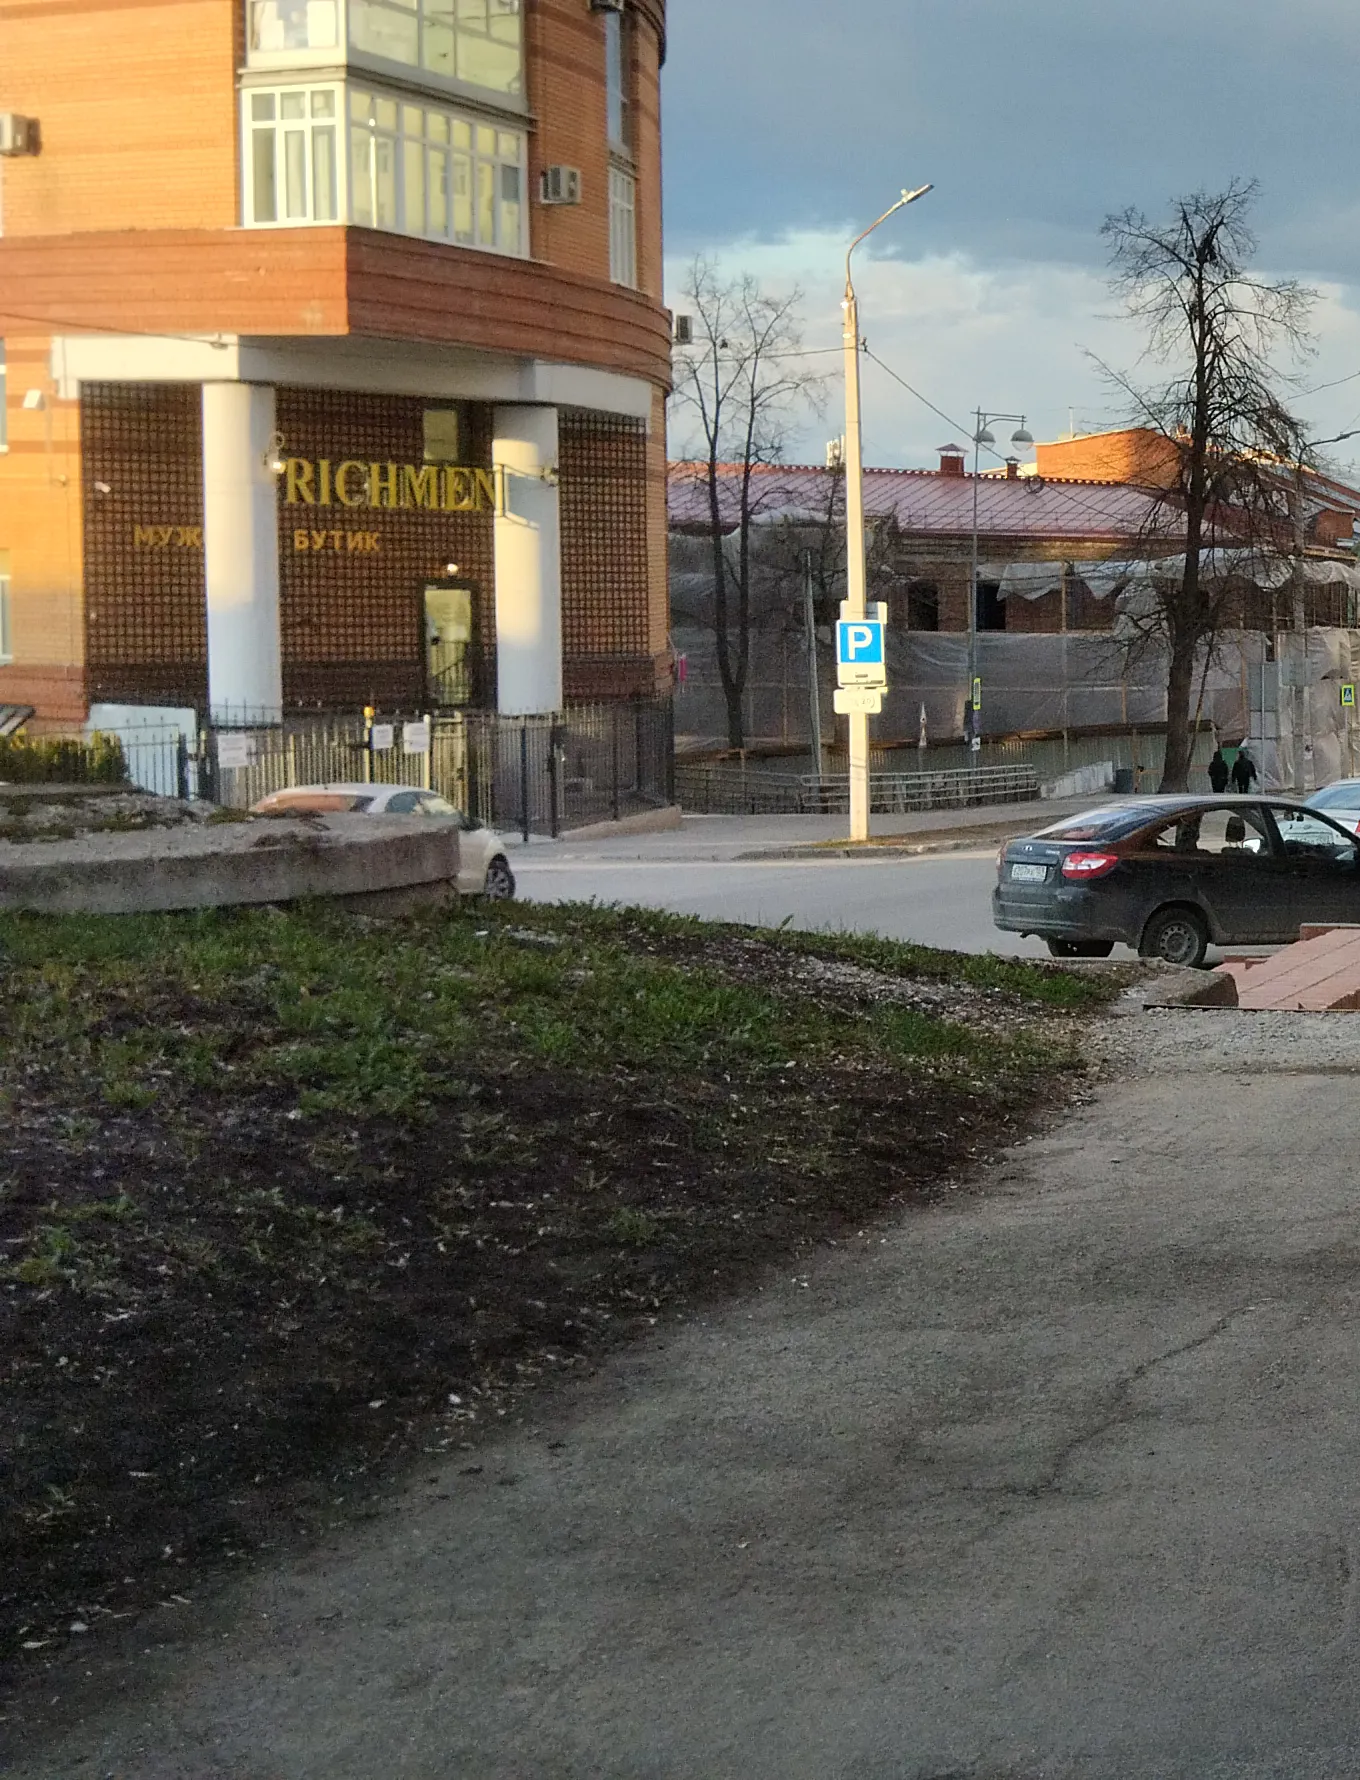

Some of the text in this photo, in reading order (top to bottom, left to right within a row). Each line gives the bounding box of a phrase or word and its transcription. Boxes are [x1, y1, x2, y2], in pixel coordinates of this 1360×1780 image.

[285, 457, 496, 511] RICHMEN
[293, 530, 381, 552] БУТИК
[848, 626, 872, 660] P
